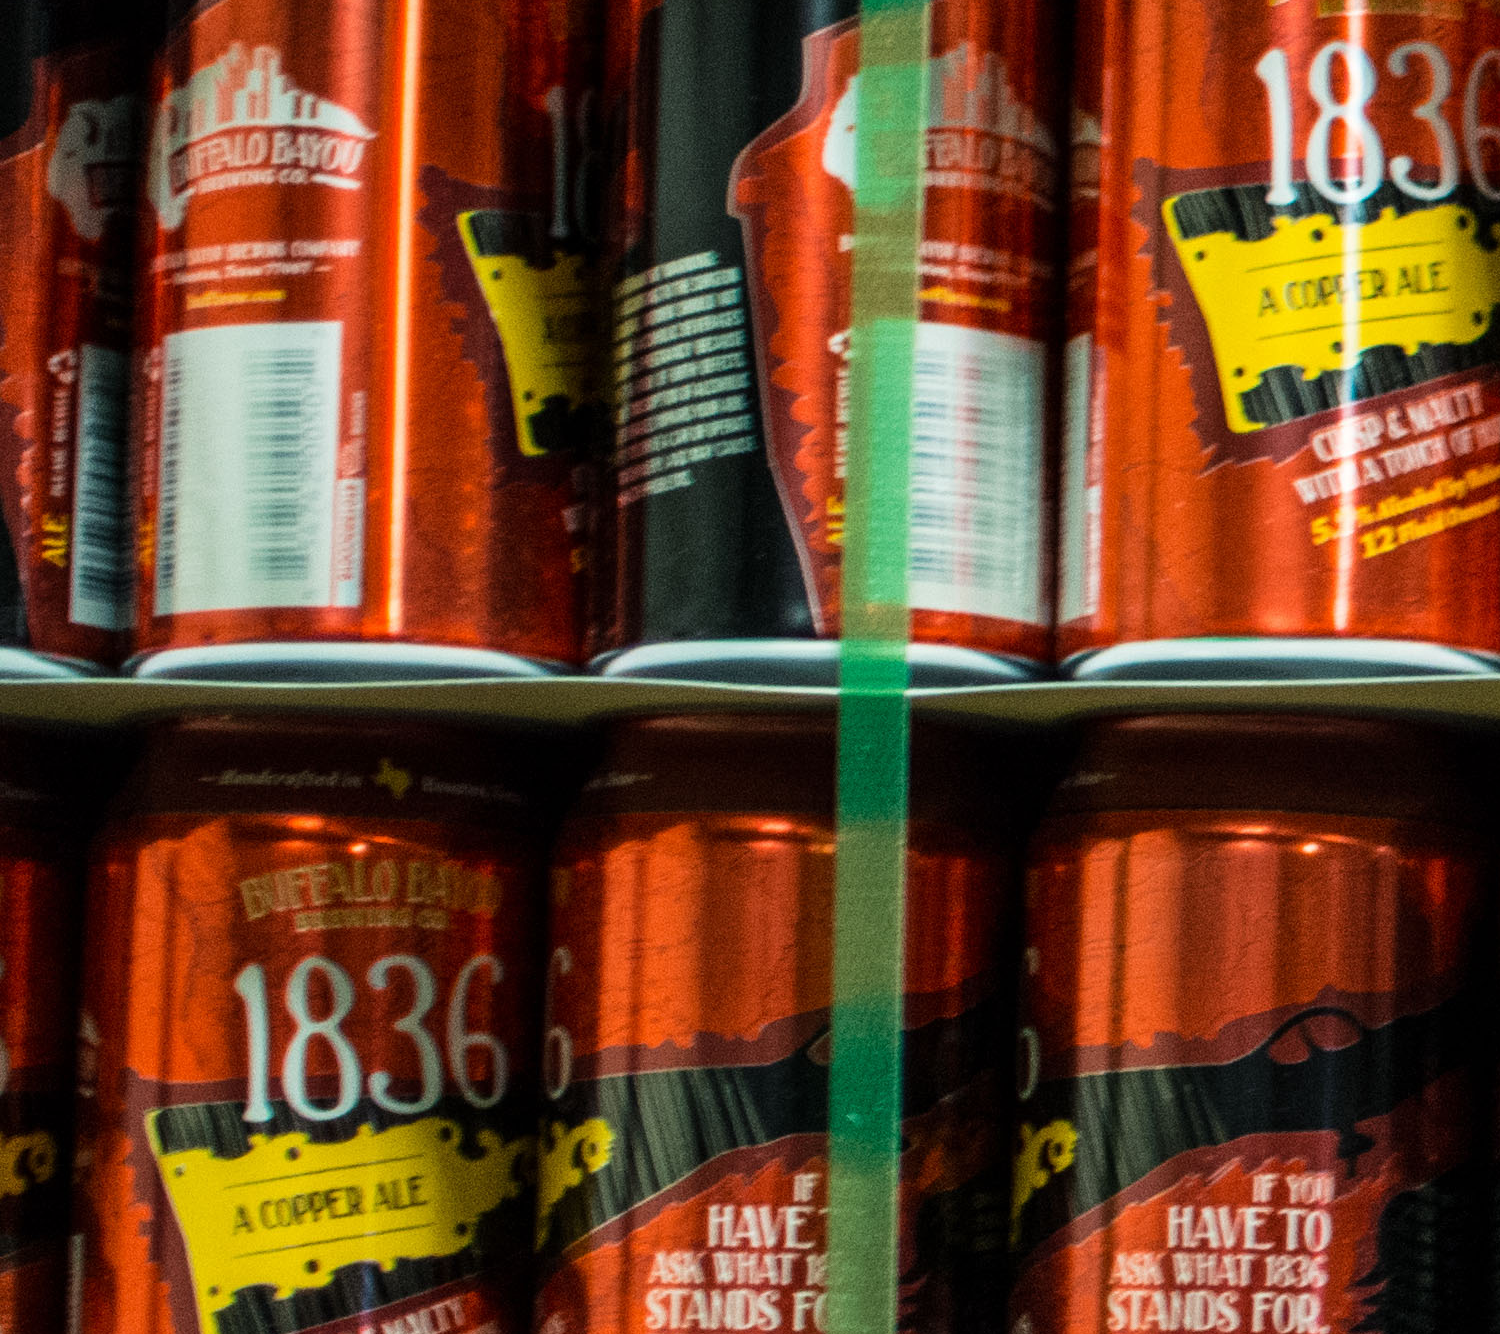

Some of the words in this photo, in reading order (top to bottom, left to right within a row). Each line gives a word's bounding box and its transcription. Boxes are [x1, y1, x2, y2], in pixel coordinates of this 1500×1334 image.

[1287, 270, 1388, 311] COPPER
[1396, 261, 1449, 297] ALE
[234, 954, 508, 1122] 1836
[260, 1186, 366, 1229] COPPER
[373, 1175, 430, 1211] ALE
[1168, 1207, 1273, 1249] HAVE
[1279, 1209, 1330, 1249] TO
[645, 1291, 780, 1331] STANDS
[1107, 1292, 1238, 1333] STANDS
